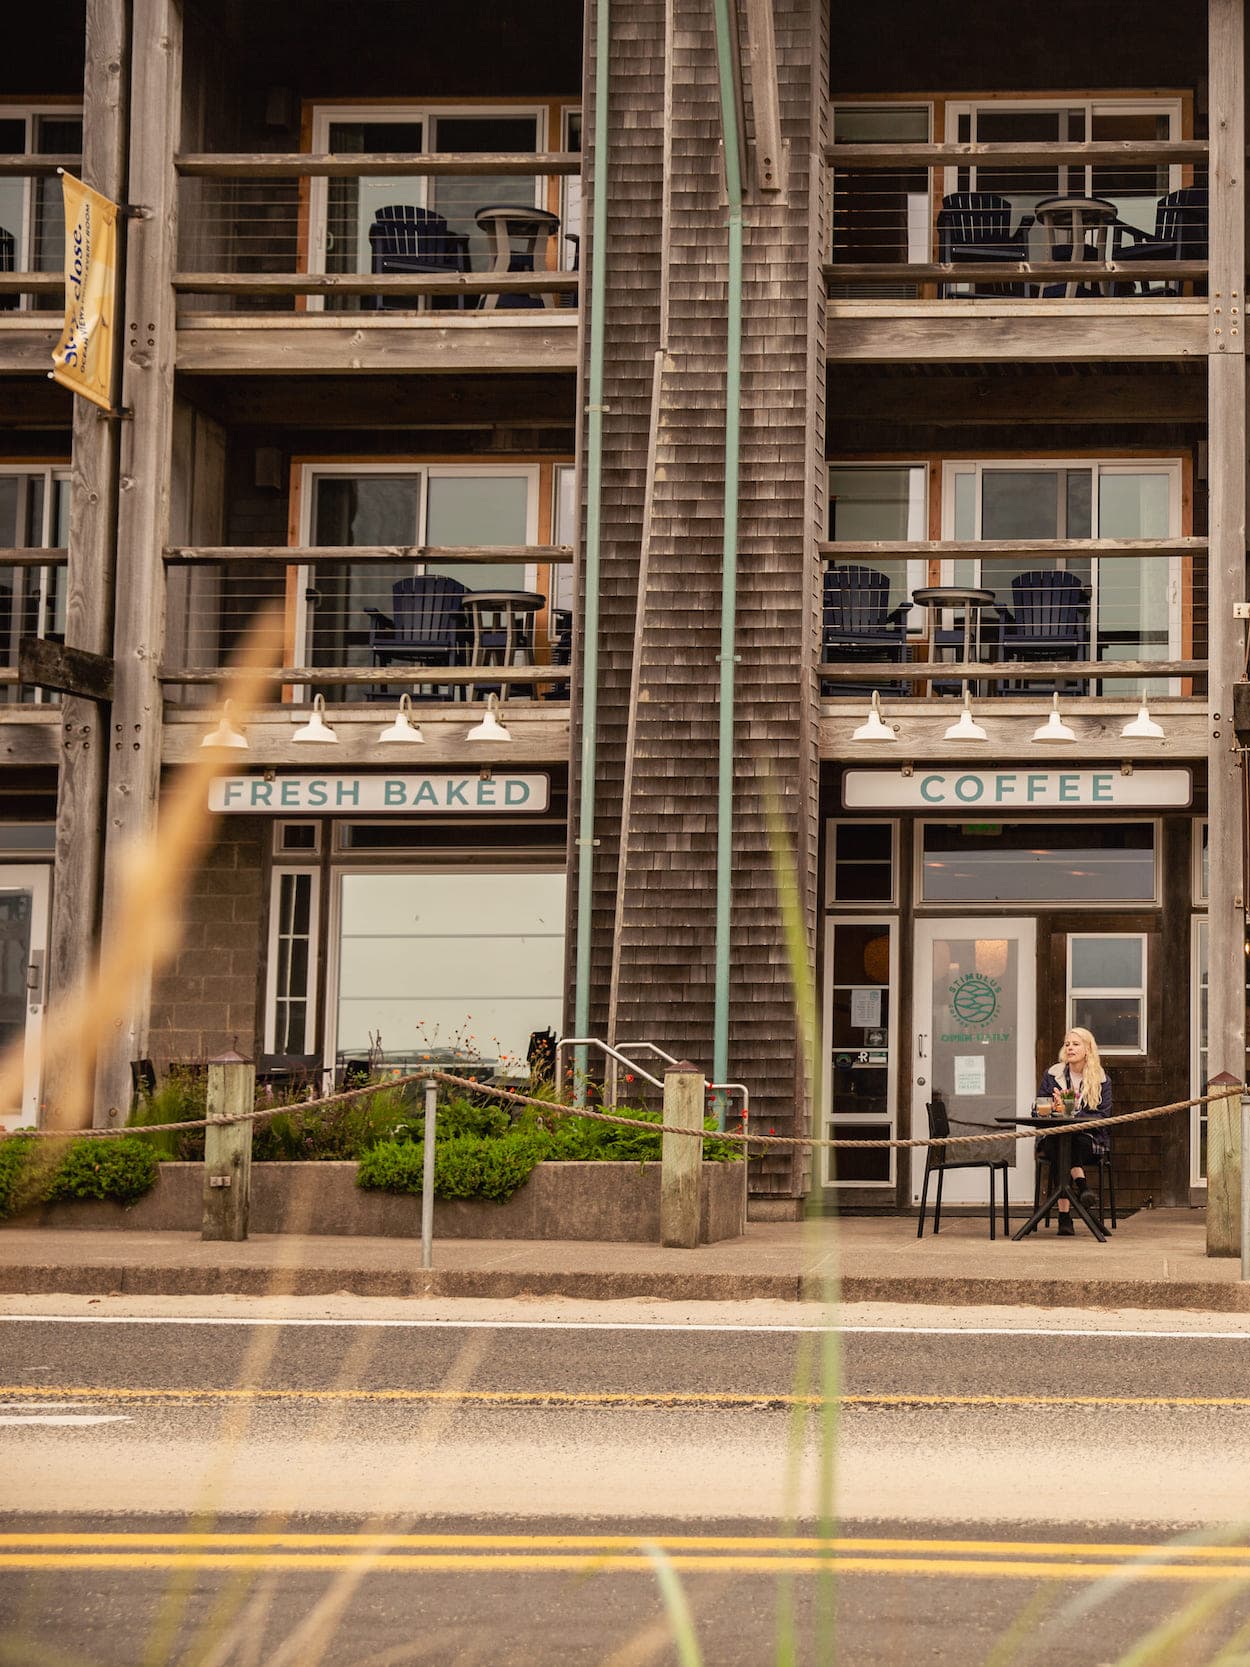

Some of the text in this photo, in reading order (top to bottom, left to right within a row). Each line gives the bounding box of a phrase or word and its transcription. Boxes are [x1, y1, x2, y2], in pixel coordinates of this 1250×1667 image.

[69, 223, 82, 301] close.
[80, 337, 89, 373] OCEAN
[223, 779, 530, 806] FRESH BAKED
[920, 775, 1114, 802] COFFEE
[948, 973, 1002, 993] STIMULUS
